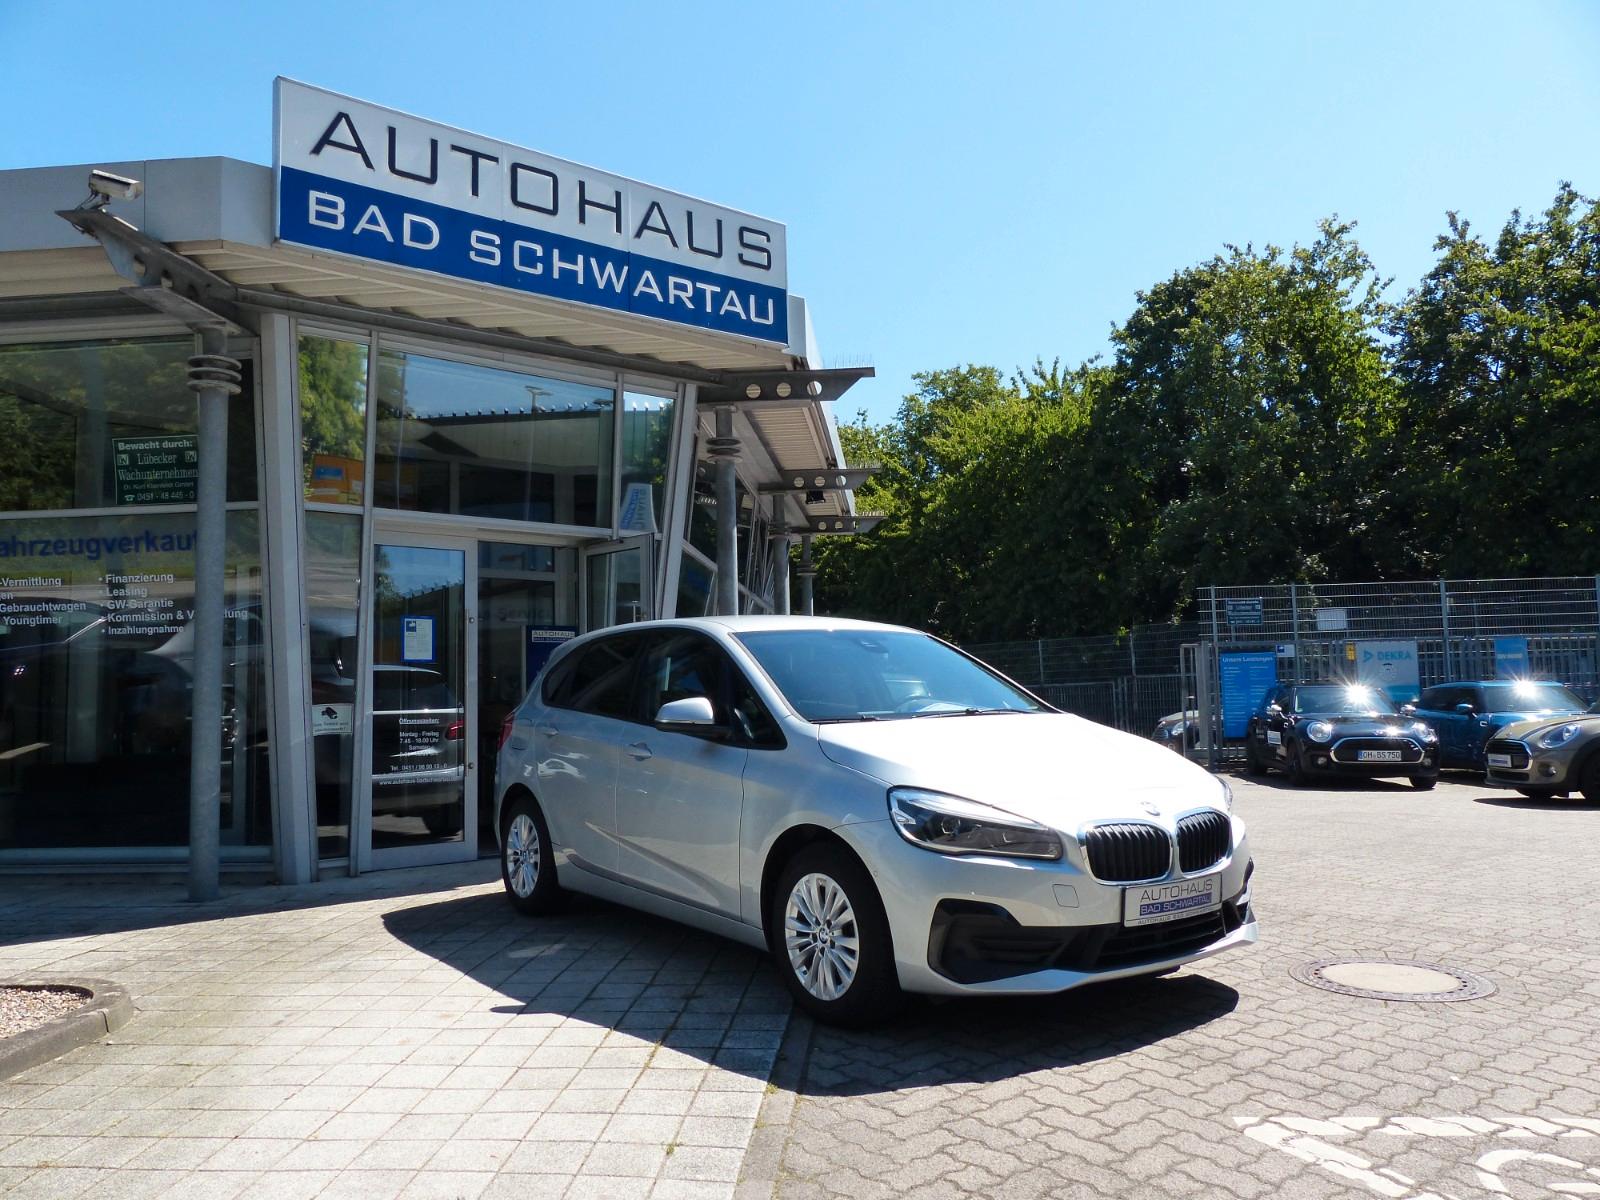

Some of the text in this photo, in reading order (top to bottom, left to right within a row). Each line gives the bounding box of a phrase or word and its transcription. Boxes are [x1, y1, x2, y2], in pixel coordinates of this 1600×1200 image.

[309, 111, 772, 271] AUTOHAUS
[308, 189, 774, 326] BAD SCHWARTAU
[118, 439, 193, 451] Bewacht durch:
[137, 452, 177, 465] Lübecker
[105, 573, 174, 583] Finanzierung
[106, 587, 148, 598] Leasing
[0, 602, 87, 613] Gebrauchtwagen
[3, 615, 63, 627] Youngtimer
[107, 610, 173, 623] Kommission
[176, 610, 185, 620] &
[108, 625, 184, 636] Inzahlungnahme
[1377, 650, 1411, 660] DEKRA
[1140, 879, 1213, 902] AUTOHAUS
[1141, 895, 1211, 915] BAD SCHWARTAU
